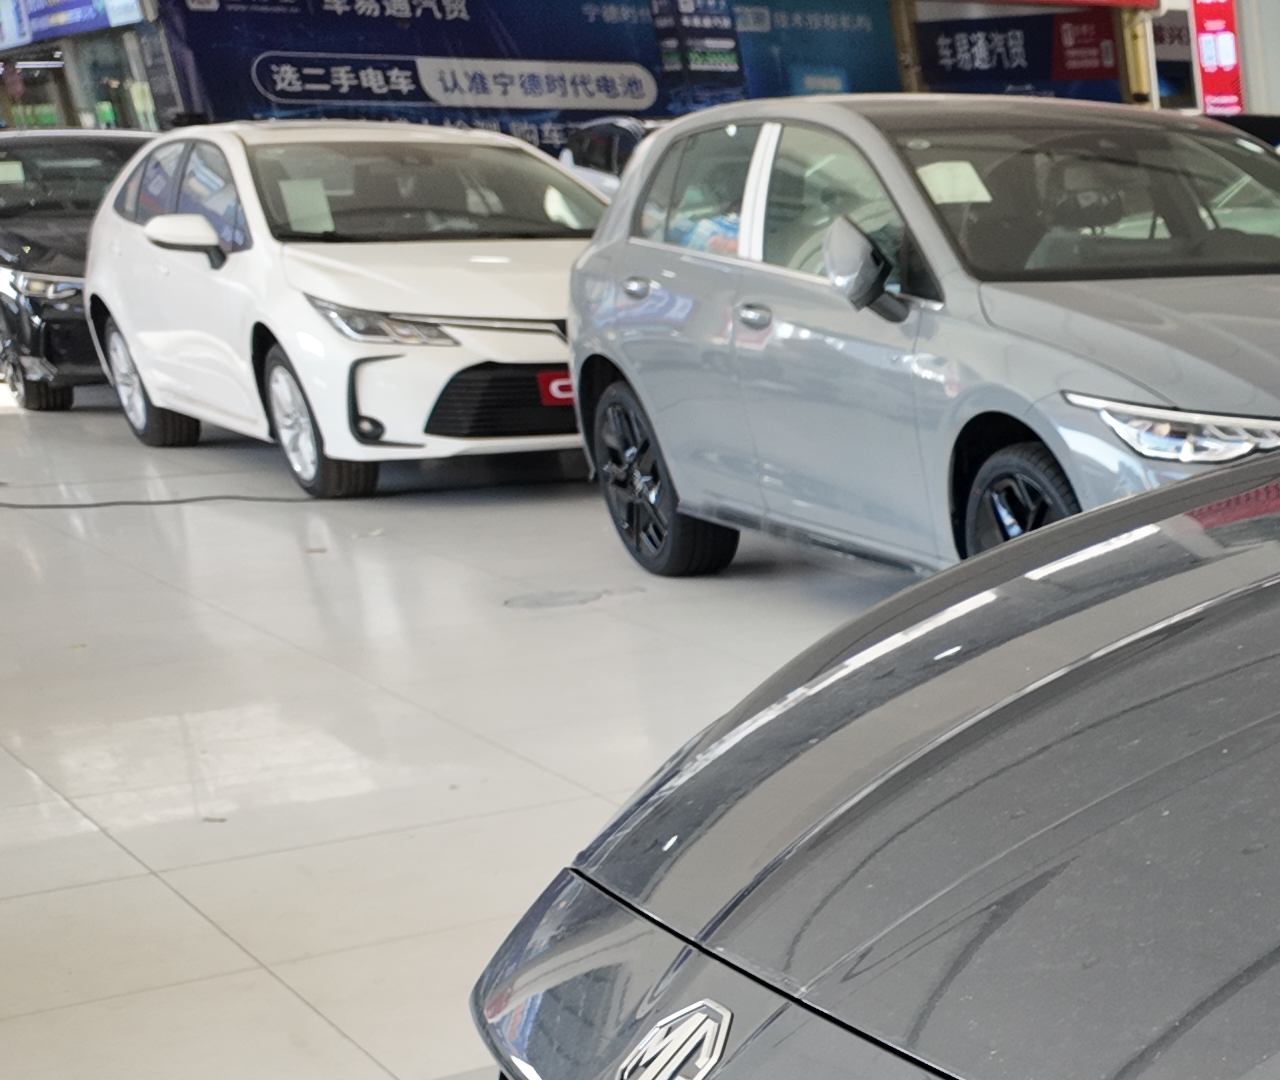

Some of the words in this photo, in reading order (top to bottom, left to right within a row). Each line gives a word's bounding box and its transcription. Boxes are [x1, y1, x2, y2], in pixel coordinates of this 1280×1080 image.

[270, 63, 416, 94] 选二手电车
[438, 69, 646, 99] 认准宁德时代电池
